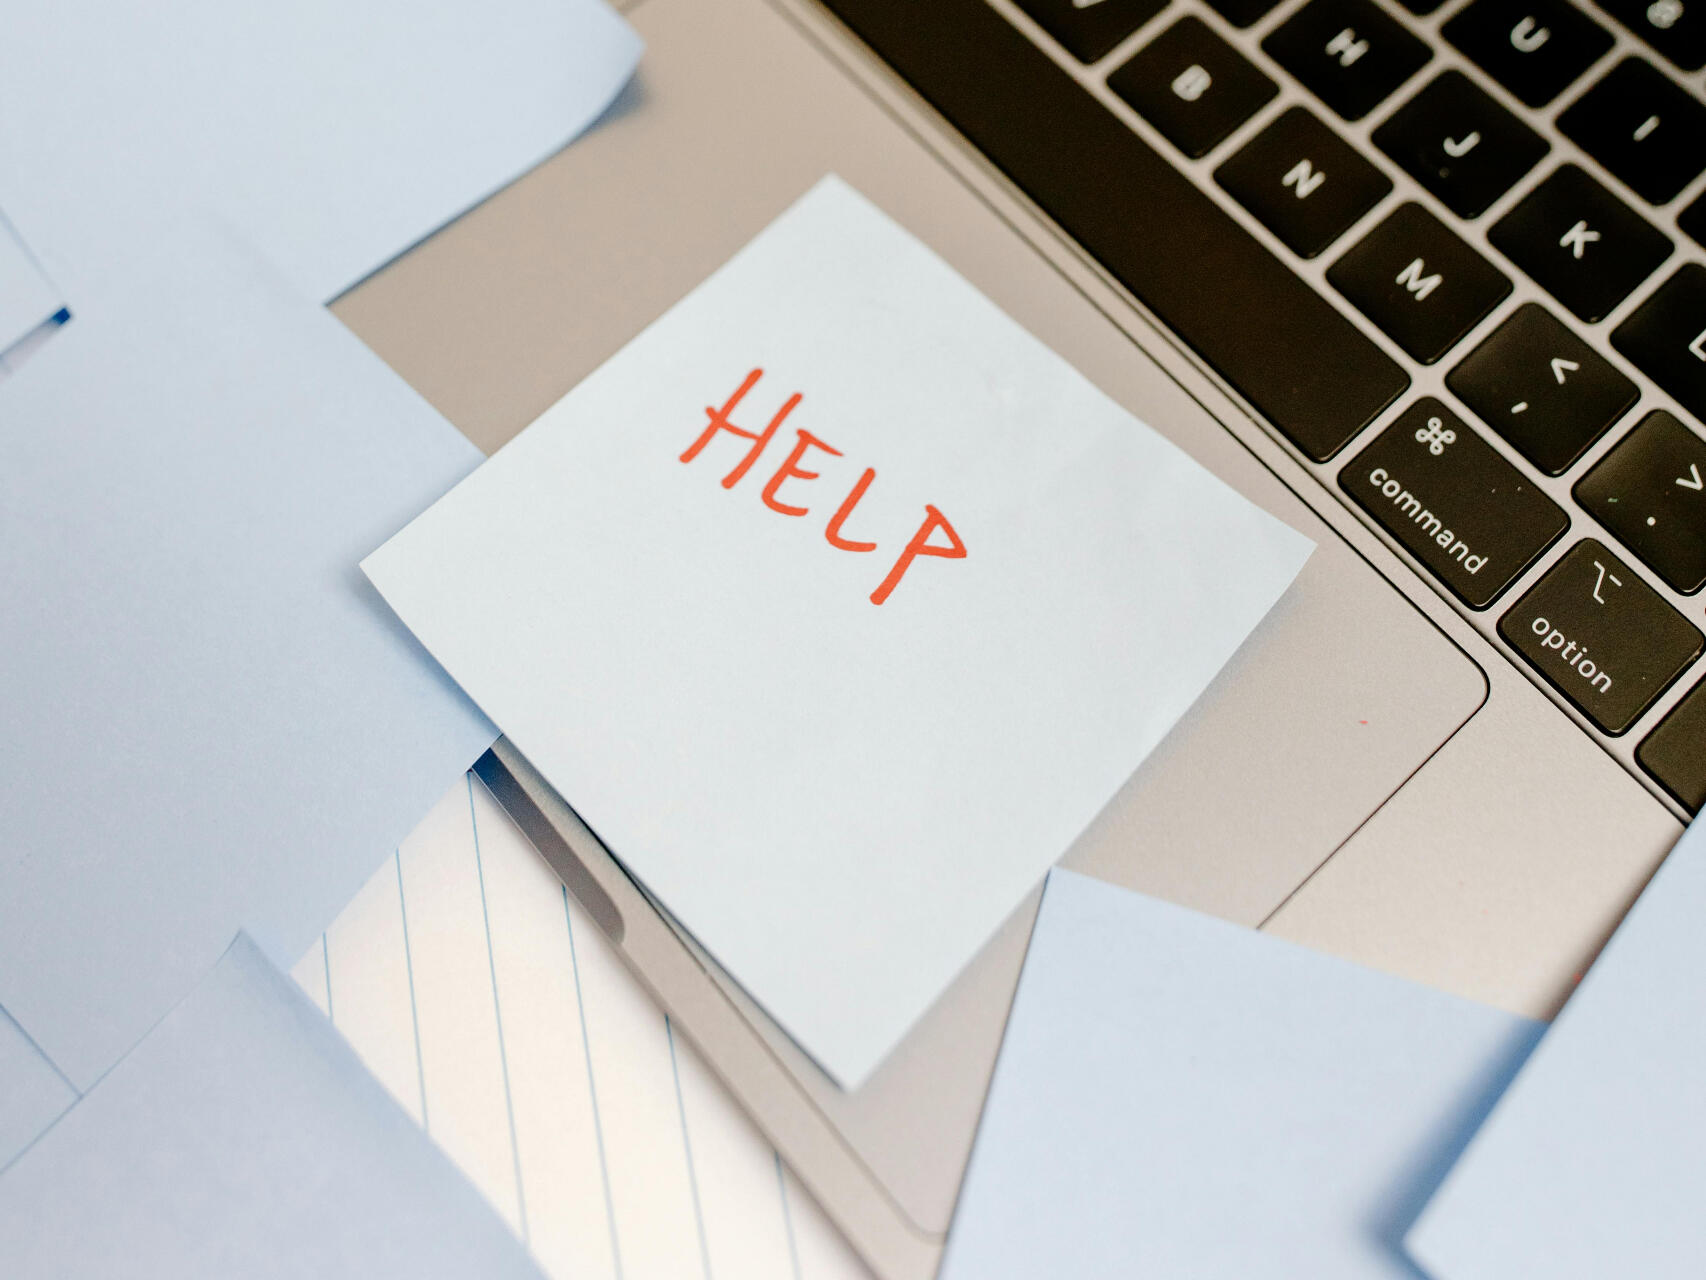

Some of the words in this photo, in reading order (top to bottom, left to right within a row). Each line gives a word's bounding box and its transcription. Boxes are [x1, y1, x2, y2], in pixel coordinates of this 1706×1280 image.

[1326, 28, 1368, 67] H
[1510, 16, 1549, 53] U
[1171, 64, 1212, 102] B
[1443, 131, 1480, 158] J
[1633, 115, 1659, 141] I
[1282, 159, 1325, 199] N
[1559, 220, 1600, 259] K
[1395, 258, 1443, 301] M
[679, 367, 967, 606] HELP
[1369, 468, 1489, 575] command
[1531, 617, 1613, 694] option
